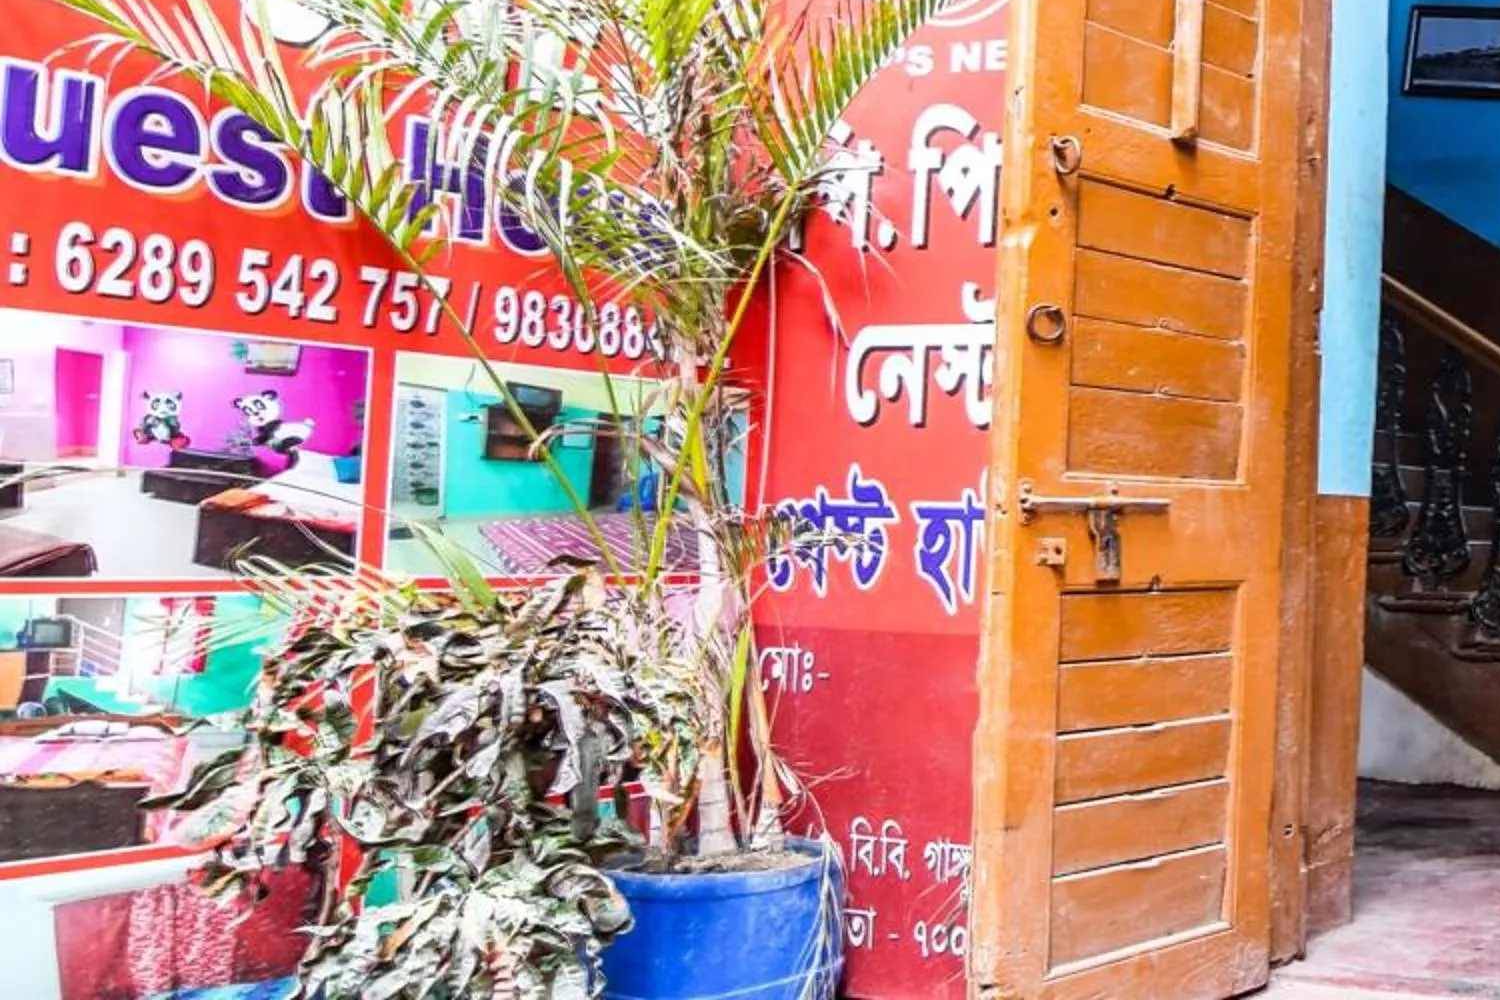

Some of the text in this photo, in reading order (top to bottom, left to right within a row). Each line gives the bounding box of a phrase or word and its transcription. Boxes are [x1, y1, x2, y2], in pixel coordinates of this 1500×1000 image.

[55, 221, 216, 306] 6289
[236, 247, 341, 325] 542
[360, 265, 451, 336] 757
